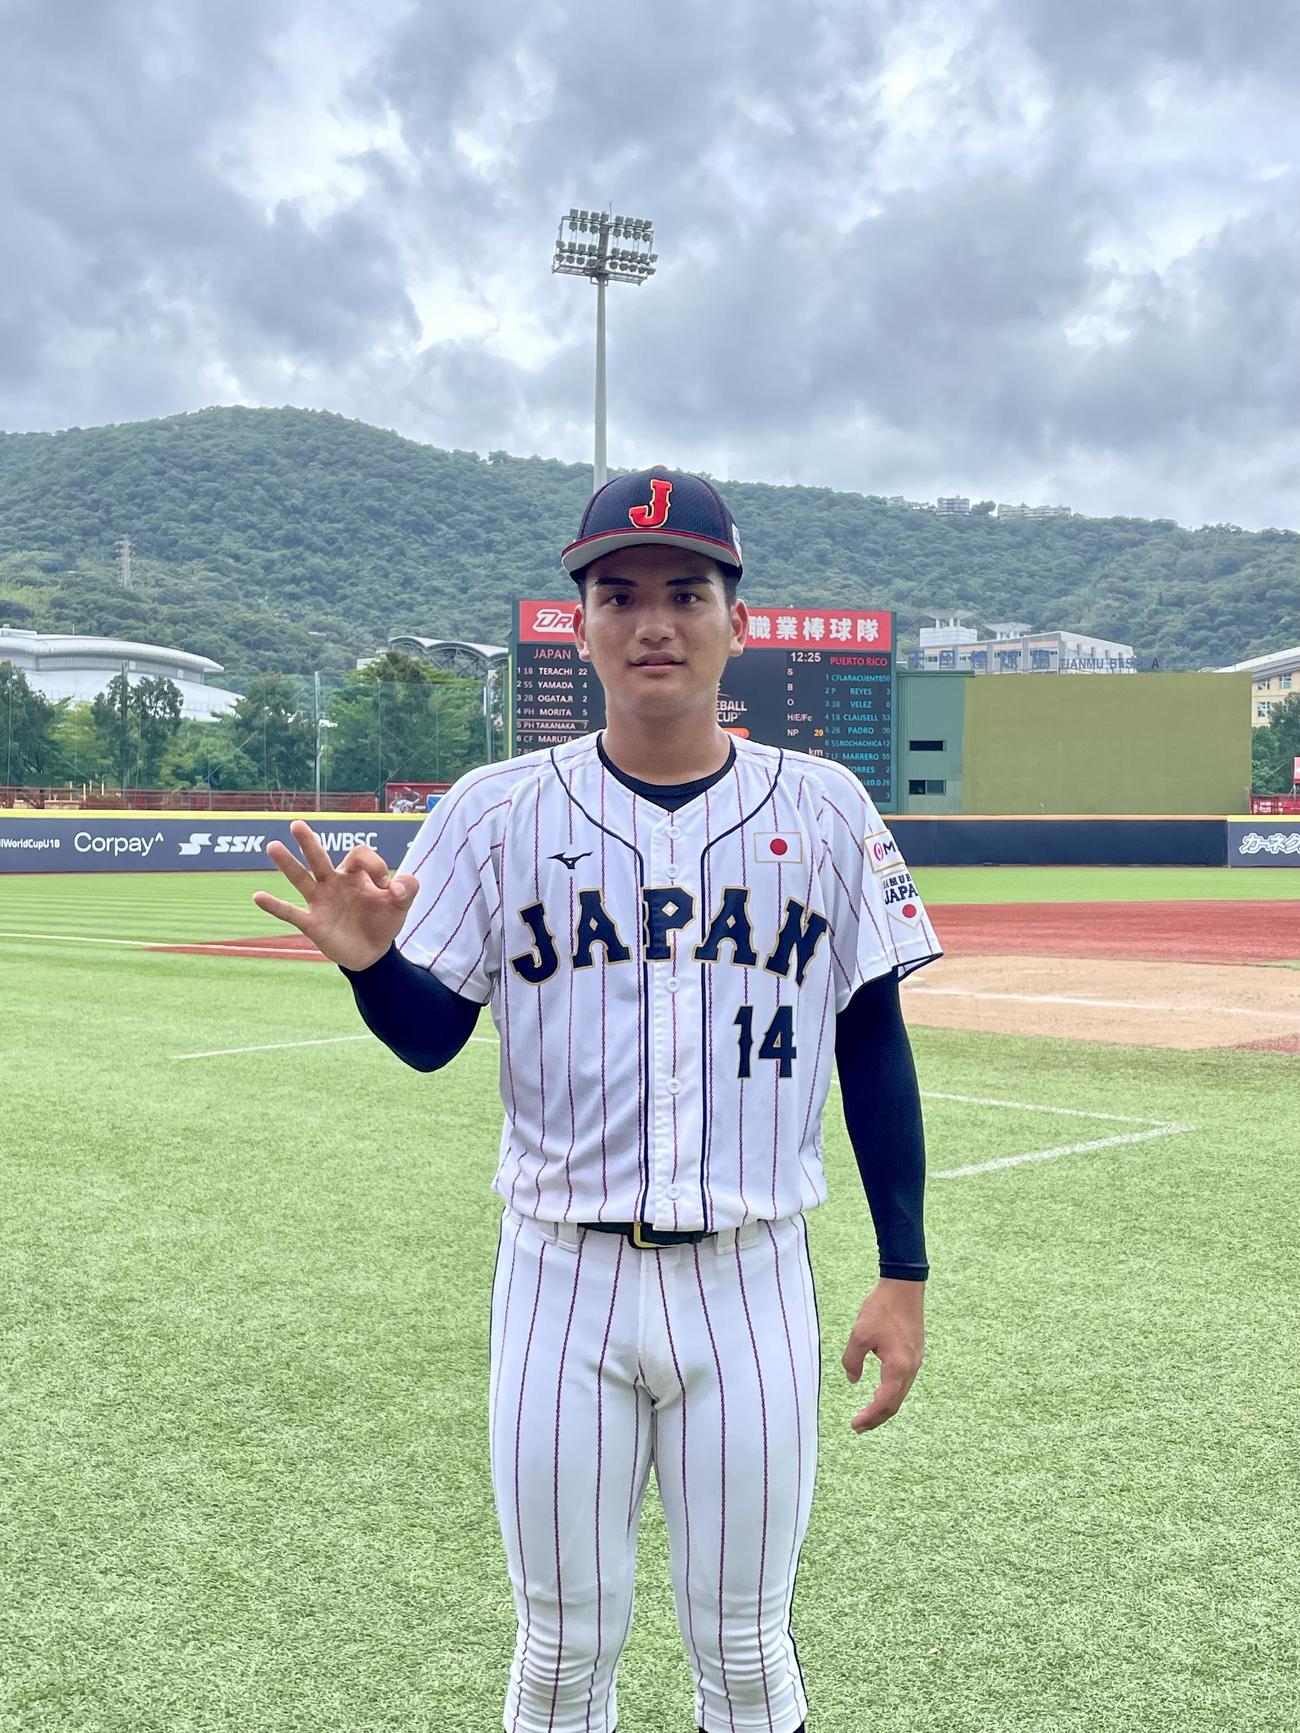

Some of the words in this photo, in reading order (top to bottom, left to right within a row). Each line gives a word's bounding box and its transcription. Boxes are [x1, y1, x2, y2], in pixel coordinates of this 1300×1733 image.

[629, 478, 673, 528] J
[748, 615, 879, 642] 職業棒球隊
[533, 648, 571, 660] JAPAN
[790, 652, 821, 662] 12:25
[830, 656, 865, 665] PUERTO
[866, 657, 888, 666] RICO
[539, 667, 573, 675] TERACHI
[578, 668, 588, 676] 22
[786, 668, 793, 676] S
[538, 681, 573, 689] YAMADA
[786, 683, 793, 691] B
[517, 694, 522, 702] 3
[850, 700, 872, 708] VELEZ
[540, 708, 572, 716] MORITA
[843, 714, 879, 722] CLAUSELL
[536, 722, 576, 730] TAKANAKA
[847, 726, 874, 735] PADRO
[786, 729, 799, 737] NP
[814, 728, 824, 737] 20
[517, 735, 522, 743] 6
[538, 735, 573, 743] MARUTA
[808, 747, 823, 757] km
[843, 752, 879, 761] MARRERO
[214, 835, 266, 852] SSK
[320, 832, 378, 852] WBSC
[885, 883, 919, 905] JAPA
[509, 885, 828, 990] JAPAN
[733, 1005, 797, 1078] 14
